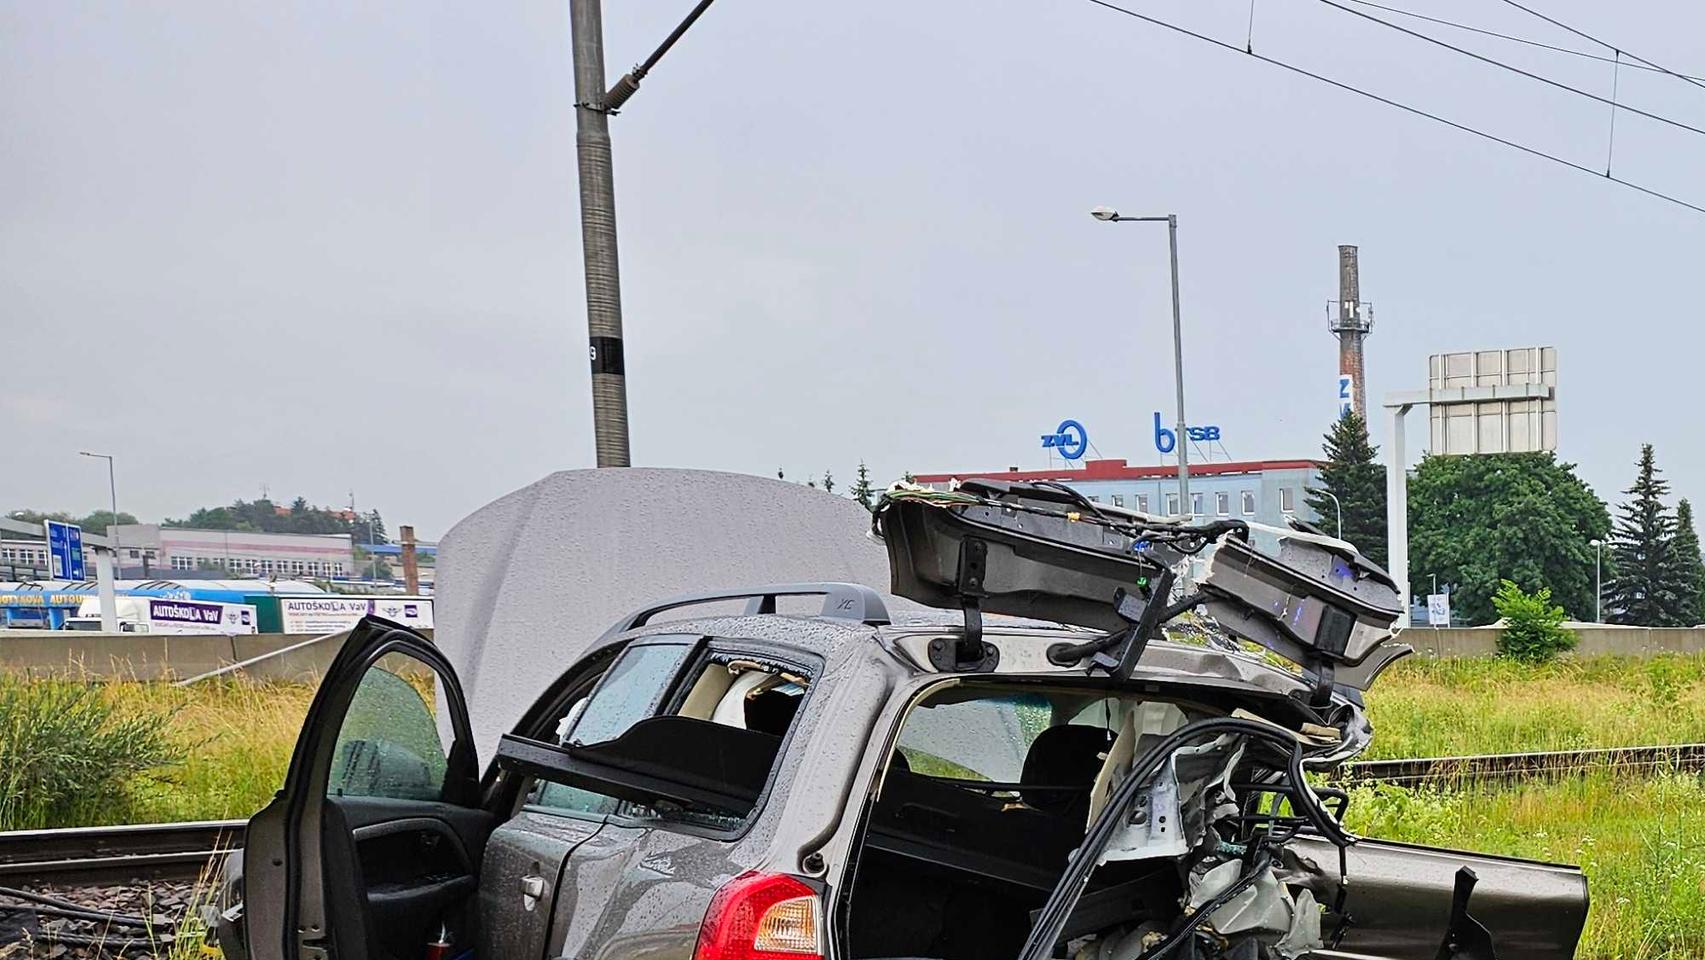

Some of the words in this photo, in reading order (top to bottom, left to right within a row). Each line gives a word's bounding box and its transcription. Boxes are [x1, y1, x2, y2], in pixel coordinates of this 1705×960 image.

[153, 603, 202, 621] AUTOŠKOLA
[203, 609, 219, 622] VaV
[288, 600, 346, 611] AUTOŠKOLA
[350, 602, 366, 611] VaV
